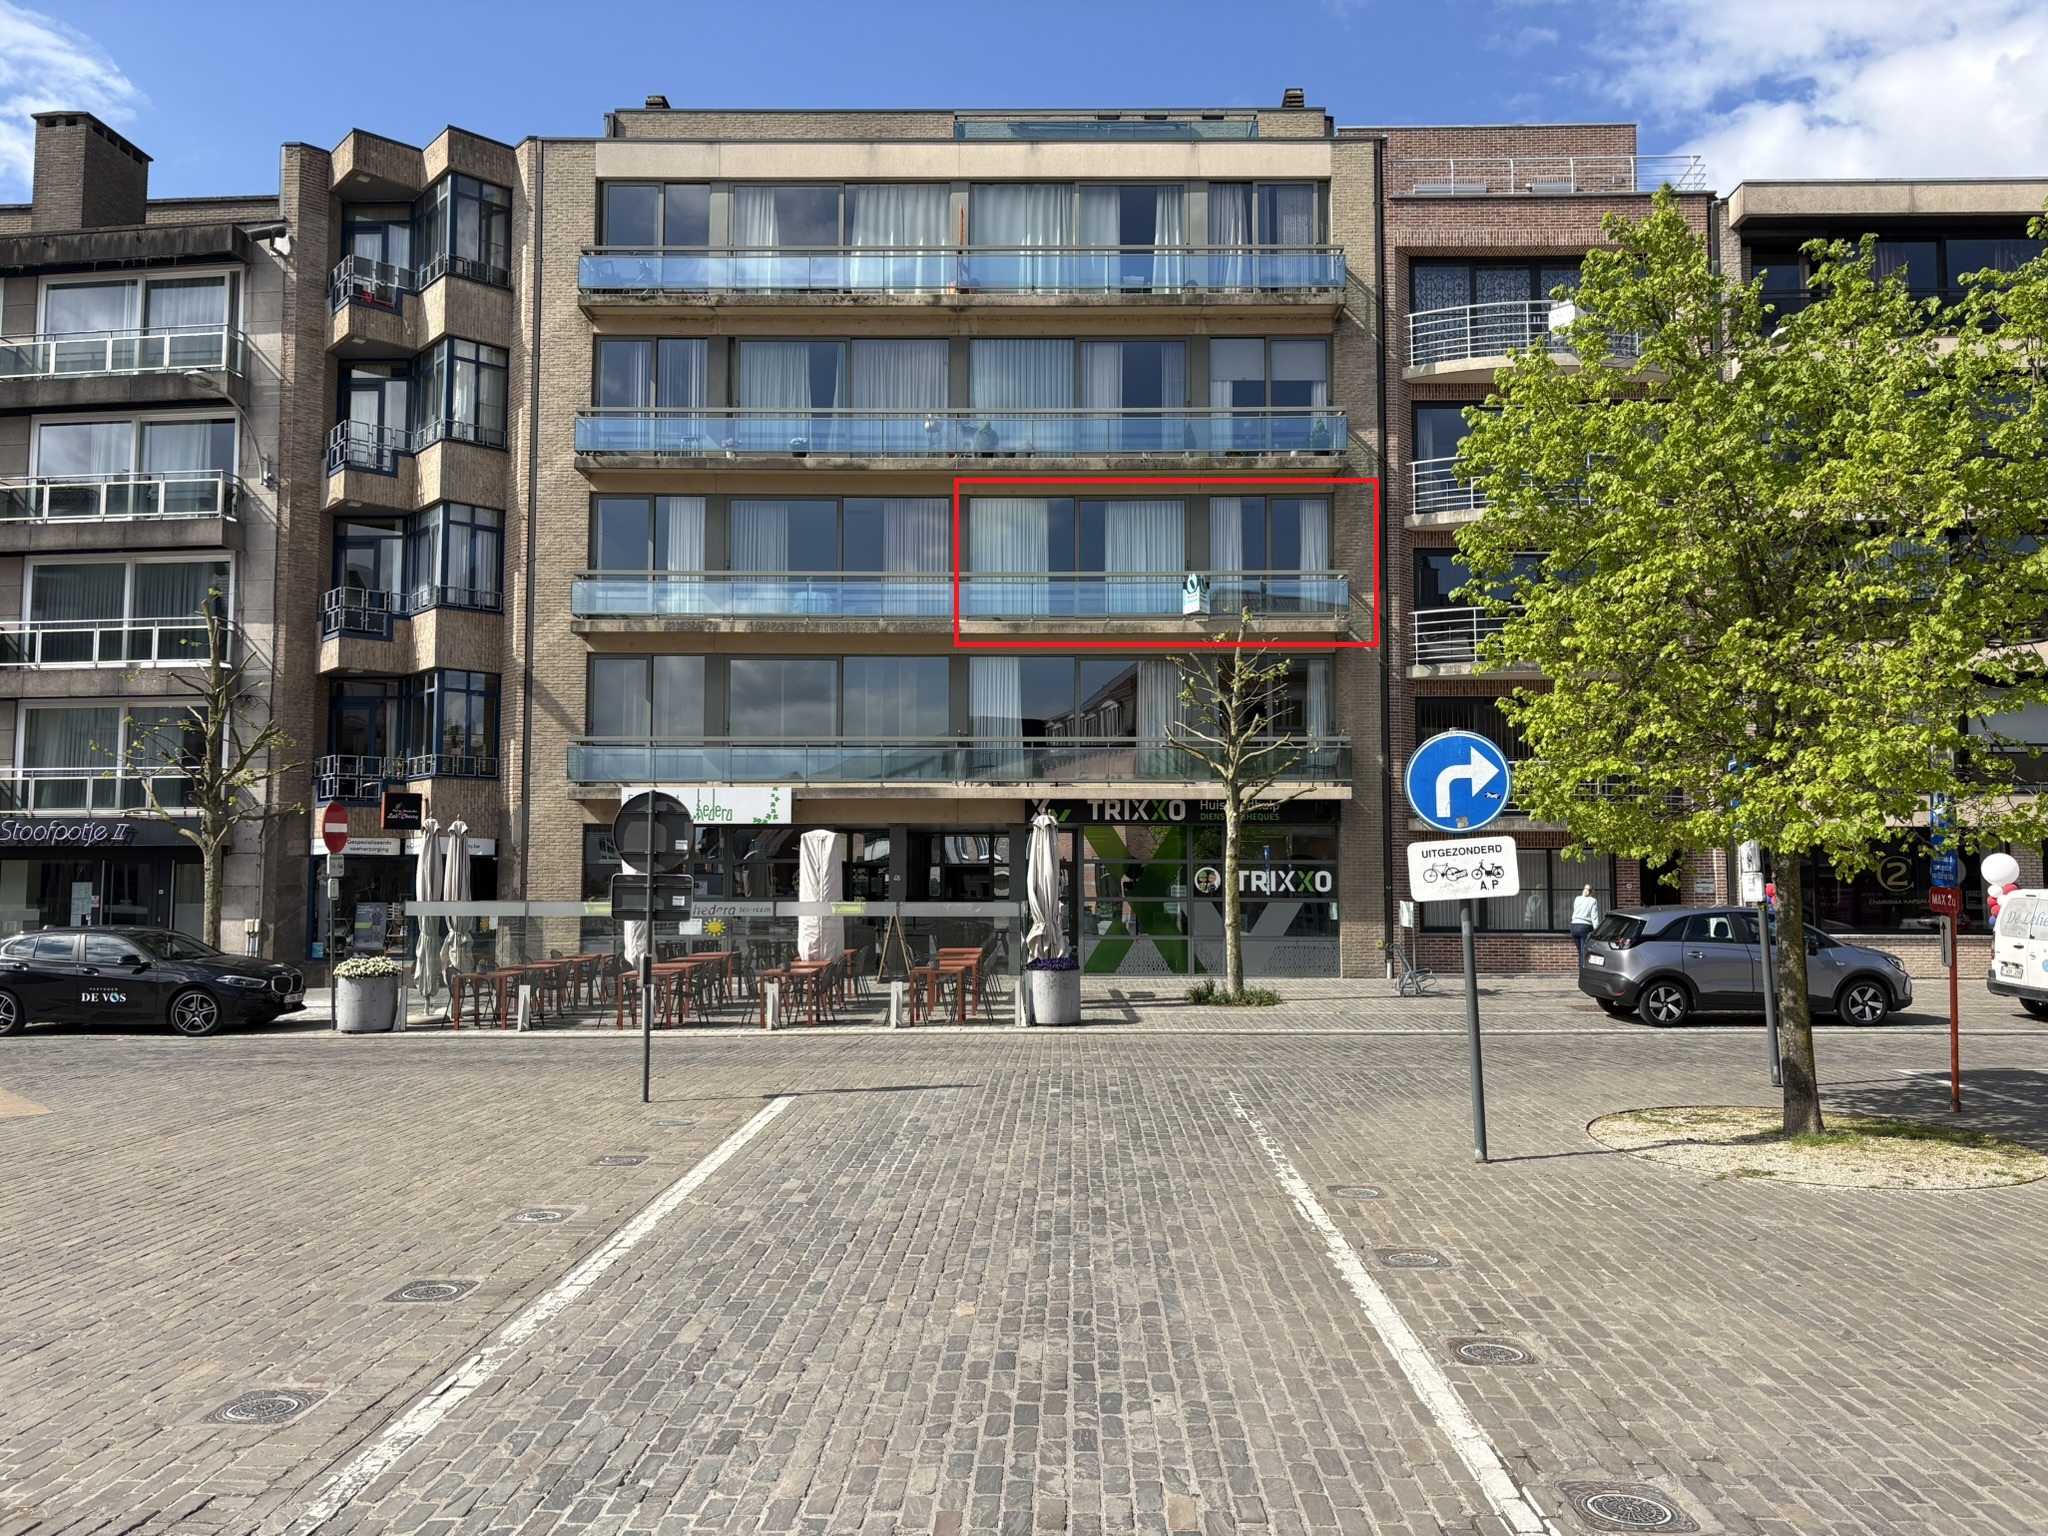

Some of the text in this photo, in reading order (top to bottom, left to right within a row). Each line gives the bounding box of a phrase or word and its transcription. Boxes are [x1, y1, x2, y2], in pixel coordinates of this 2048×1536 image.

[696, 788, 733, 821] hedera
[1087, 799, 1186, 821] TRIXXO
[0, 820, 130, 847] Stoofpotje II
[1421, 844, 1502, 859] UITGEZONDERD
[1238, 870, 1332, 893] TRIXXO
[1492, 880, 1499, 889] P
[1931, 893, 1956, 907] MAX 2u
[693, 904, 736, 916] hedera
[2007, 910, 2020, 924] De
[81, 991, 127, 1003] DE VOS
